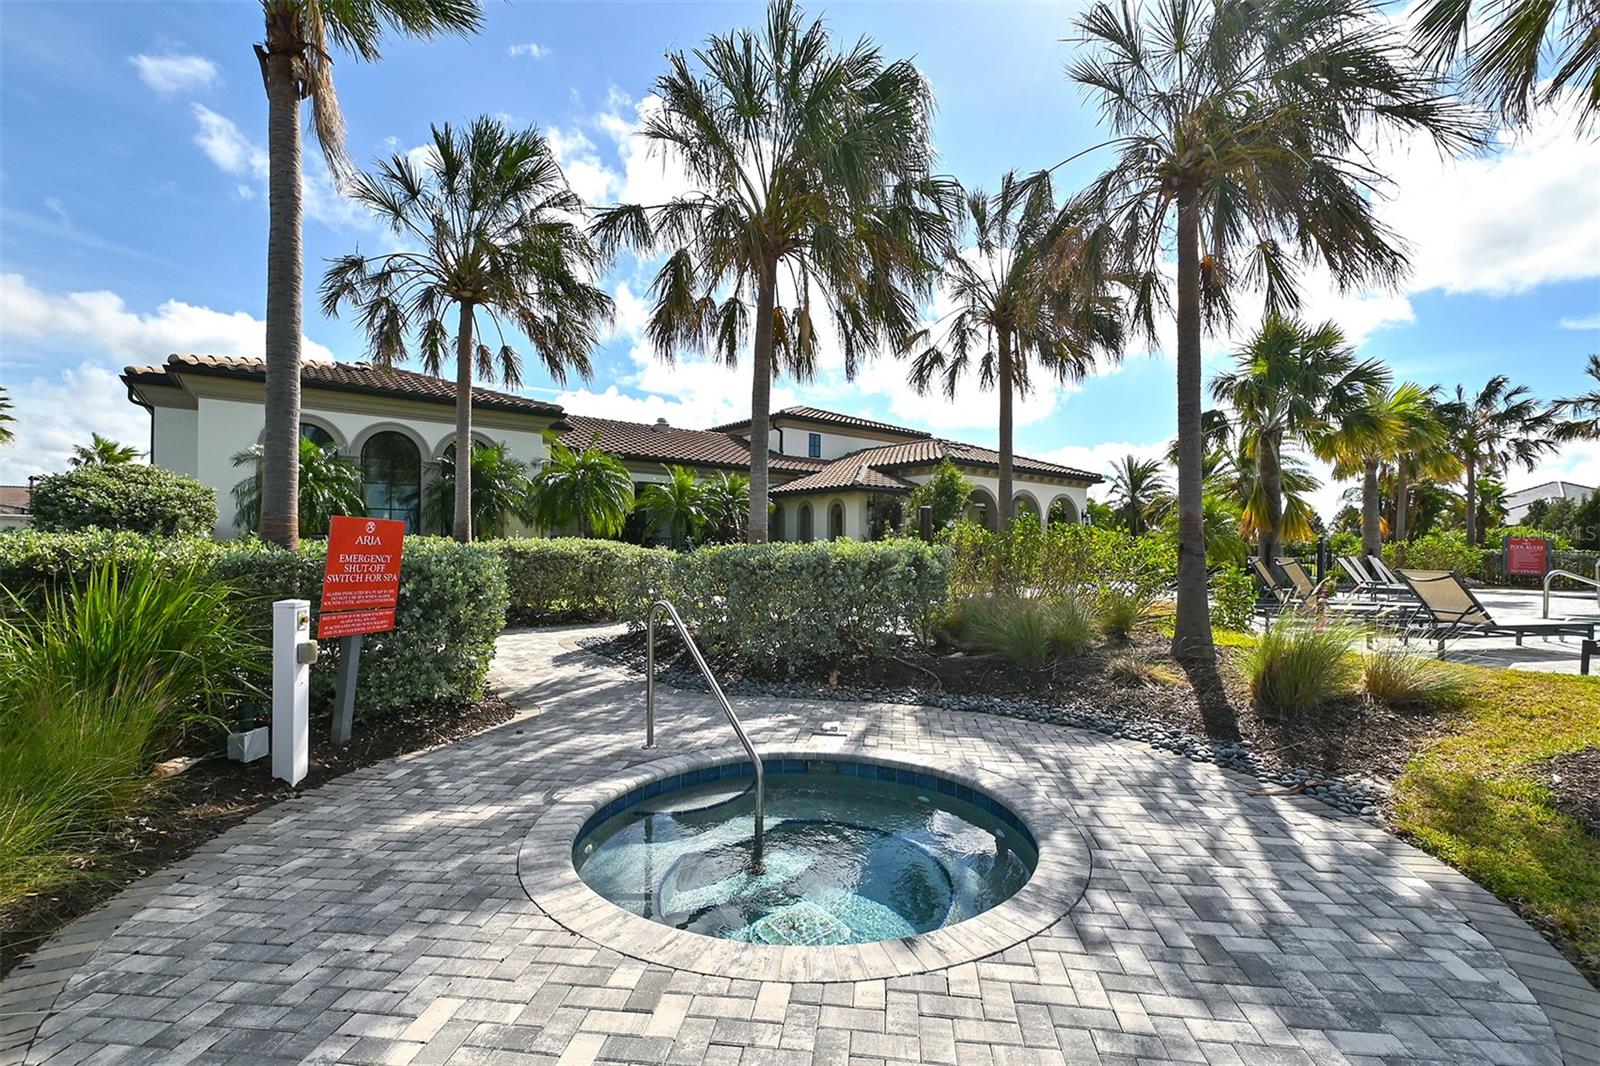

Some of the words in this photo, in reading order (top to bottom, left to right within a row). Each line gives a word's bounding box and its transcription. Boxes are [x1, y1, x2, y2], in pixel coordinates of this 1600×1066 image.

[355, 536, 382, 546] ARIA
[340, 554, 392, 563] EMERGENCY
[344, 563, 386, 573] SHUT-OFF
[326, 574, 363, 583] SWITCH
[365, 574, 382, 582] FOR
[383, 574, 398, 582] SPA
